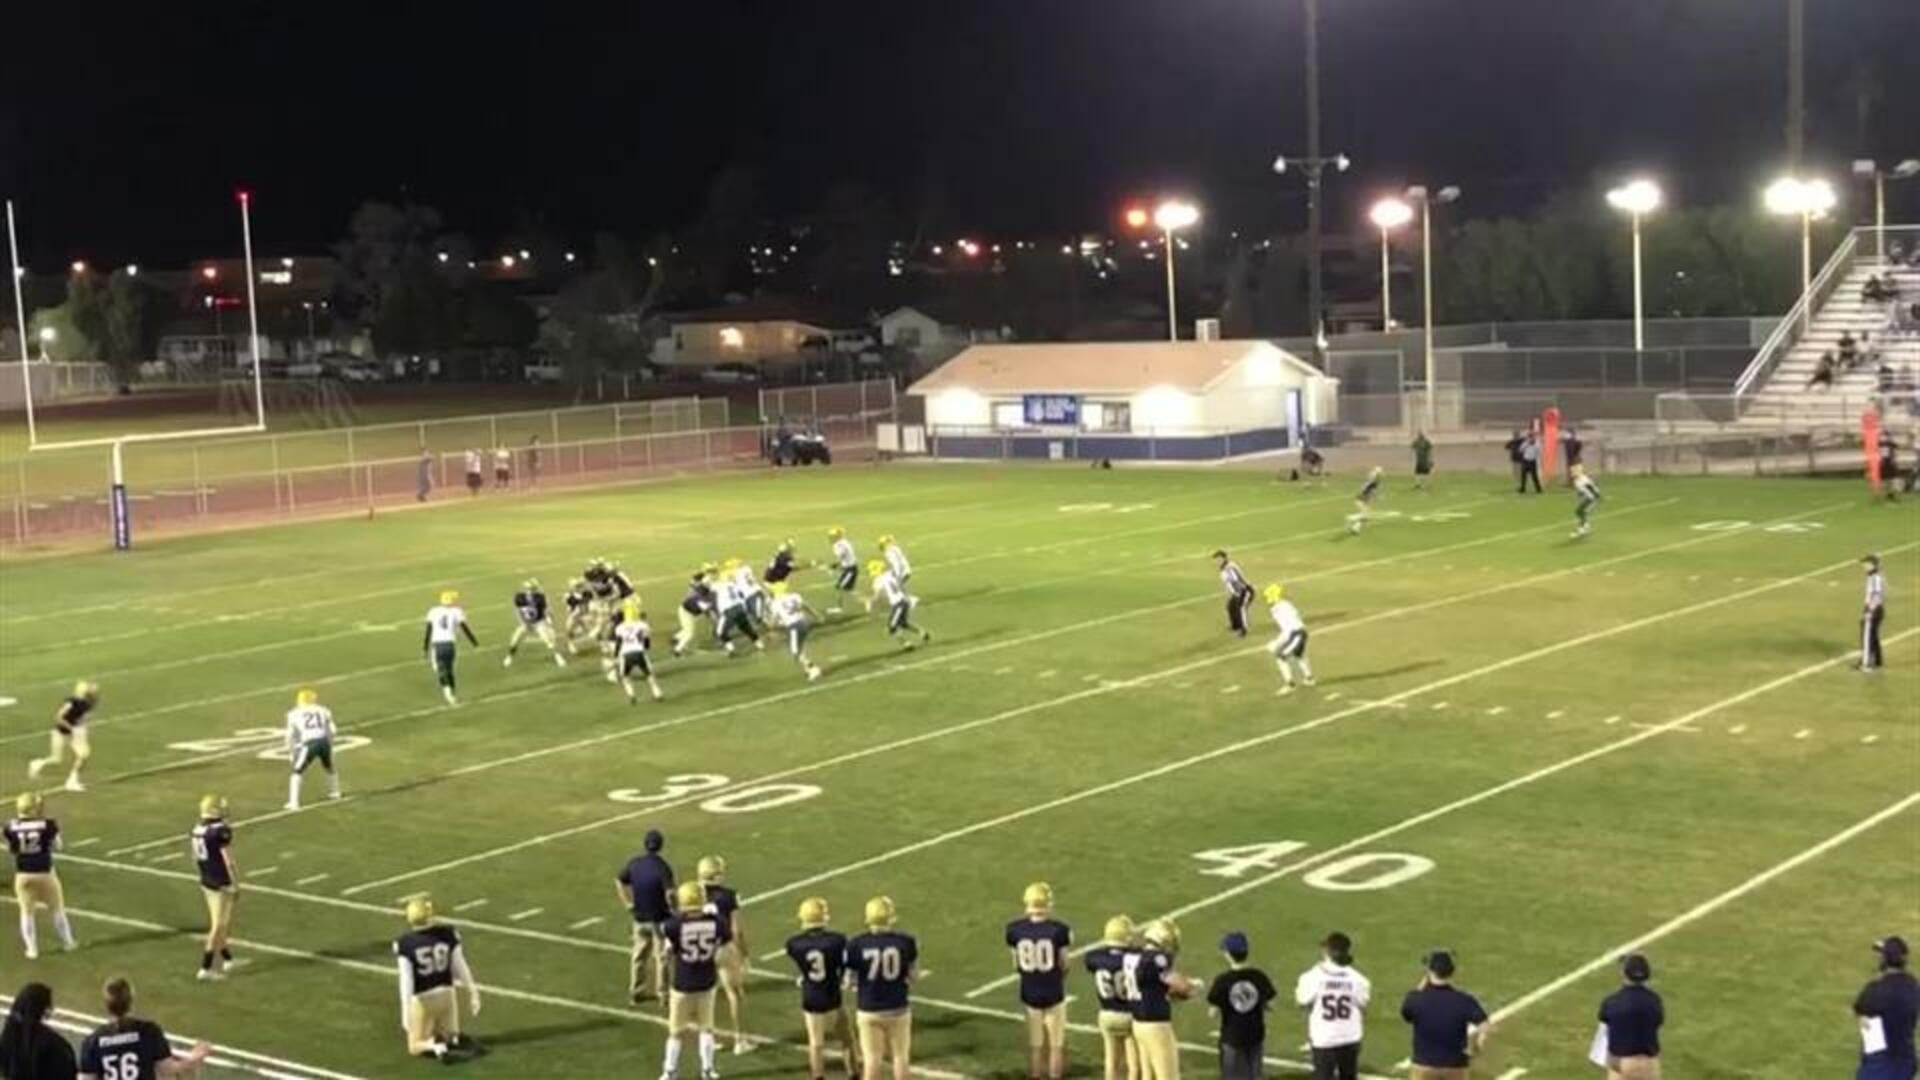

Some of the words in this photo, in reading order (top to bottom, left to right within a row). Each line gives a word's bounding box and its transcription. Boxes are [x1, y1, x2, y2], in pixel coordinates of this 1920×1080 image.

[302, 711, 322, 729] 21
[607, 773, 823, 813] 30
[1191, 839, 1436, 891] 40
[680, 930, 714, 961] 55
[806, 951, 826, 981] 3
[862, 946, 900, 979] 70
[1321, 994, 1352, 1021] 56
[102, 1051, 139, 1080] 56
